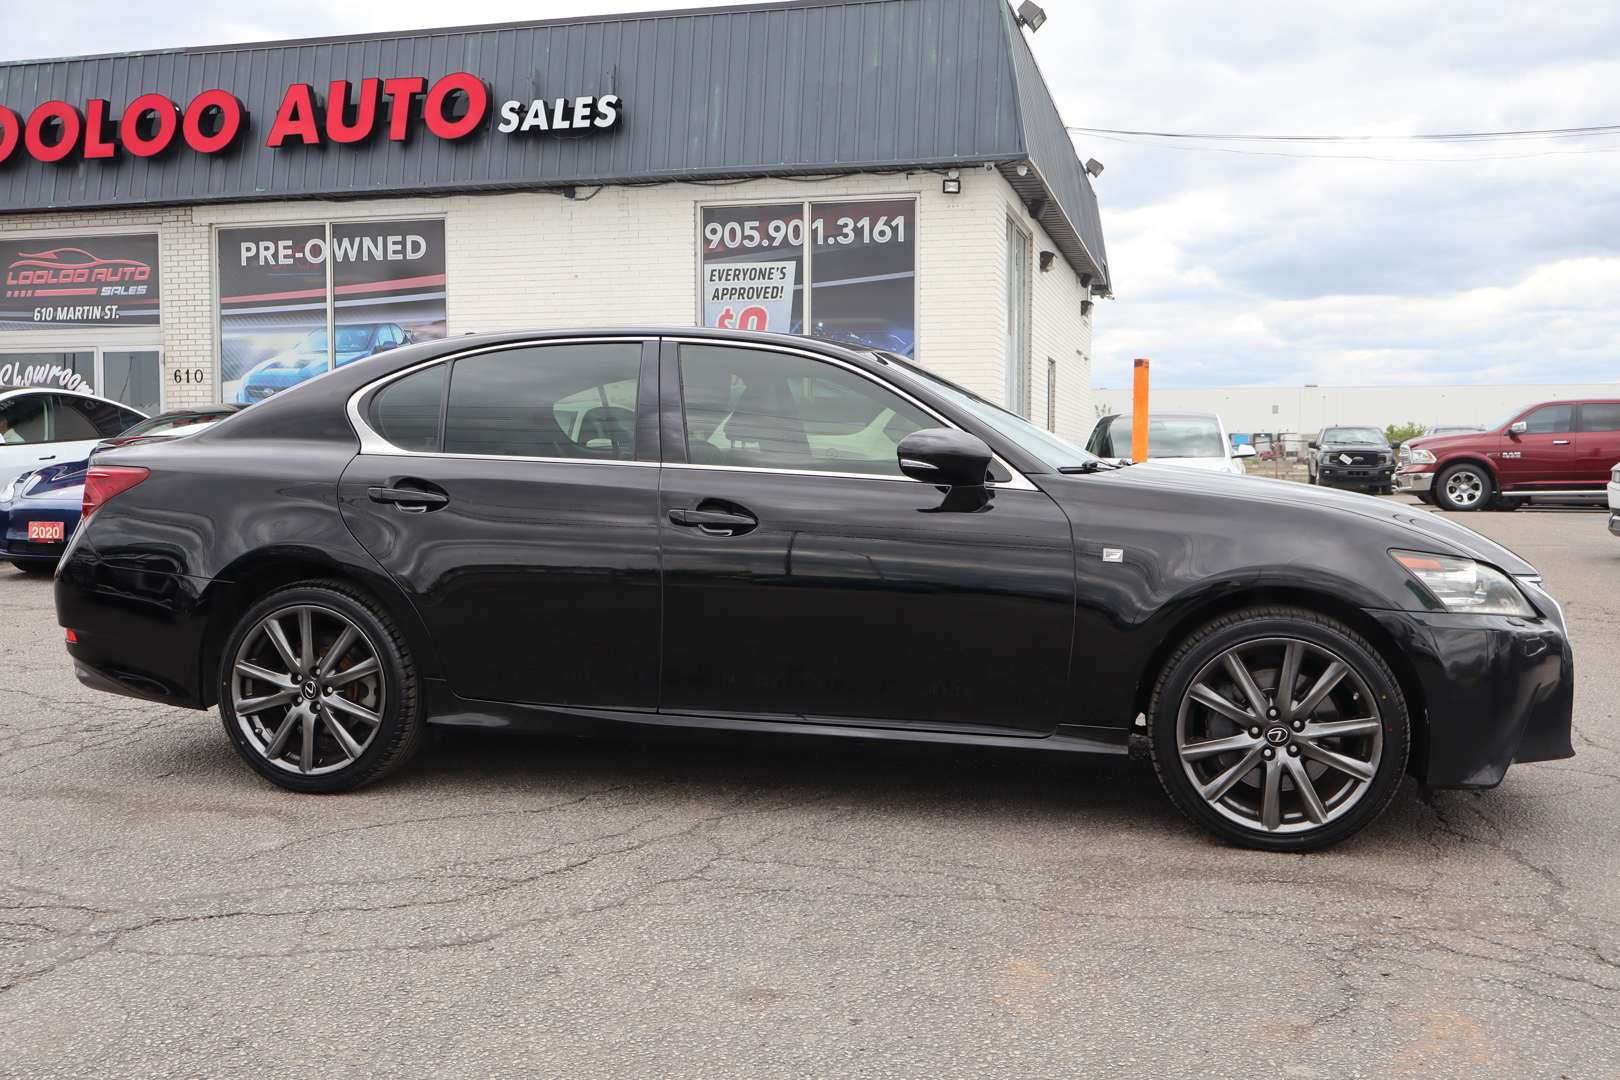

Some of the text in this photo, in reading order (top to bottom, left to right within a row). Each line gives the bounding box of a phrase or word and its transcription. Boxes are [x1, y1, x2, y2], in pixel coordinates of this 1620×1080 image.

[265, 71, 488, 147] AUTO
[497, 94, 618, 133] SALES
[704, 215, 905, 248] 905.901.3161
[240, 234, 427, 266] PRE-OWNED
[6, 267, 151, 285] LOOLOO AUTO
[709, 266, 787, 282] EVERYONE'S
[100, 285, 148, 296] SALES
[712, 286, 784, 301] APPROVED!
[33, 305, 120, 321] 610 MARTIN ST.
[174, 369, 204, 383] 610
[31, 526, 60, 539] 2020
